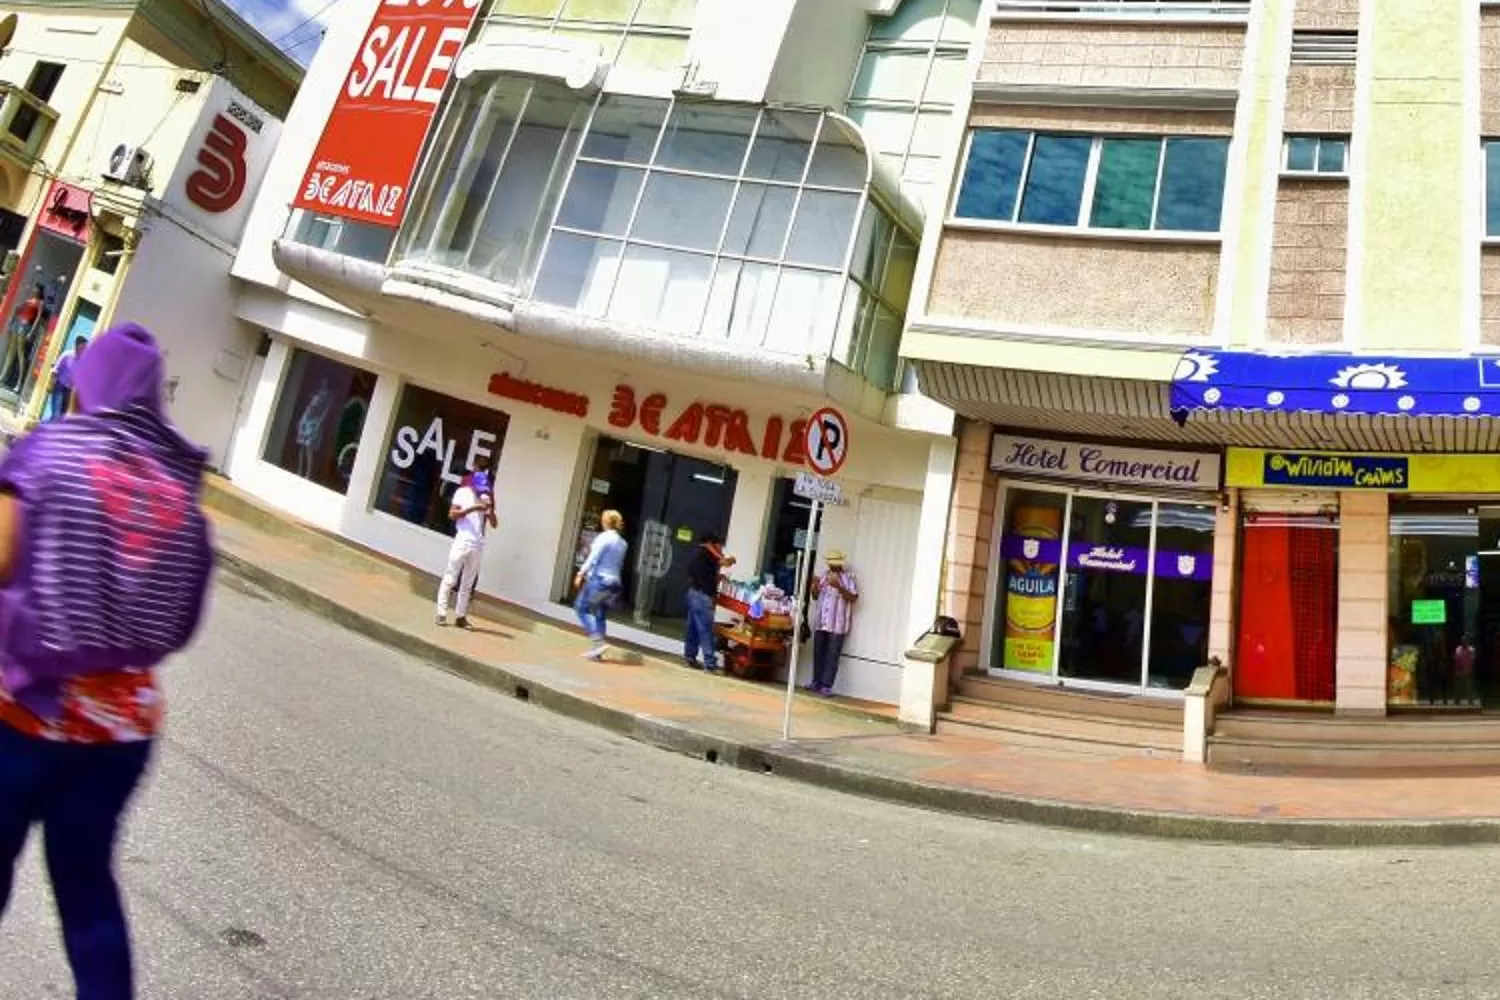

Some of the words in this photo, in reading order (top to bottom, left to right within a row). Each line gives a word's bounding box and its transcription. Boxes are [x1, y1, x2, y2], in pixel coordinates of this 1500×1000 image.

[347, 24, 466, 103] SALE
[391, 416, 497, 485] SALE
[1005, 441, 1068, 471] Hotel
[1079, 447, 1201, 483] Comercial
